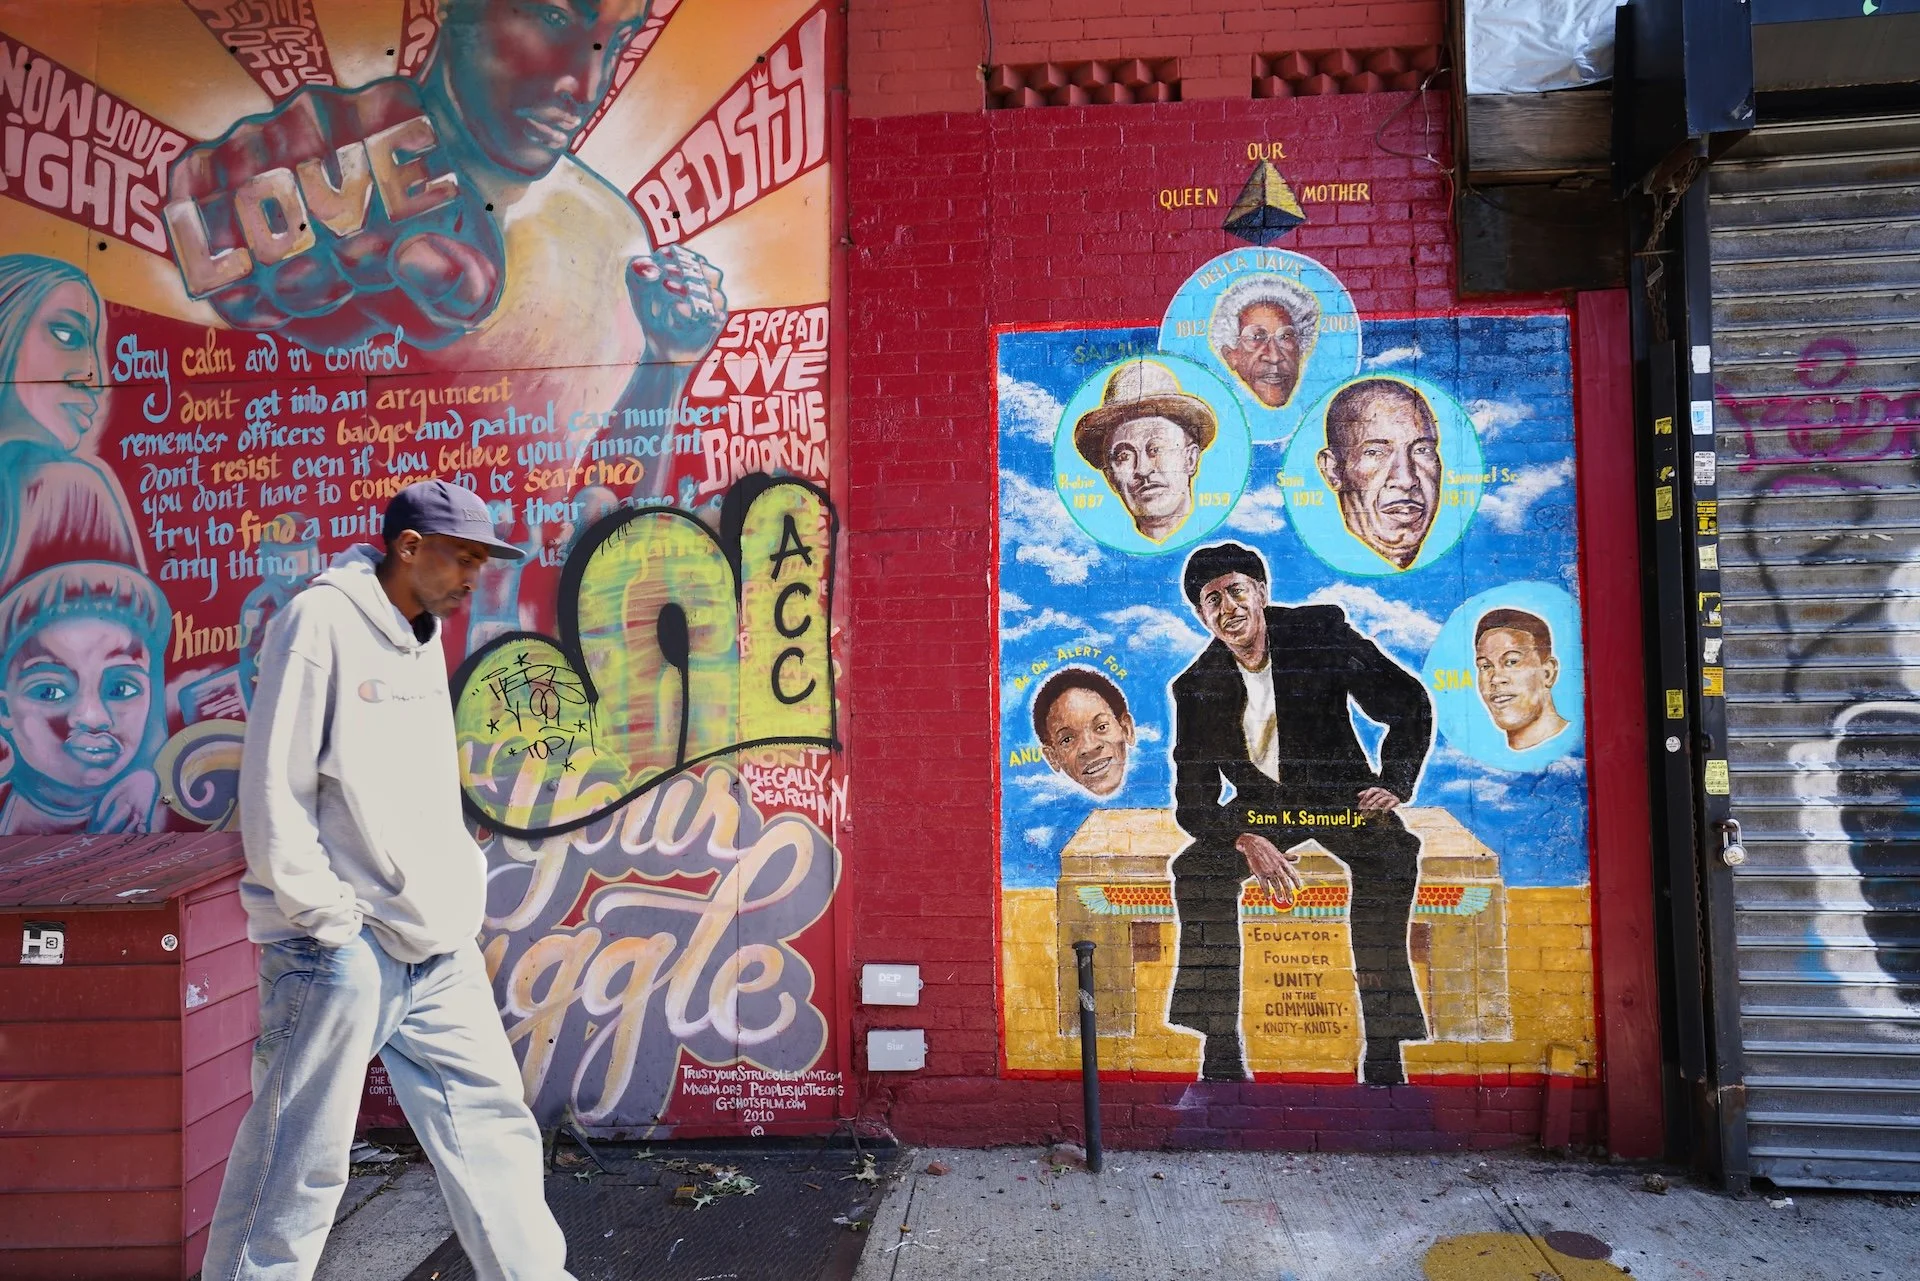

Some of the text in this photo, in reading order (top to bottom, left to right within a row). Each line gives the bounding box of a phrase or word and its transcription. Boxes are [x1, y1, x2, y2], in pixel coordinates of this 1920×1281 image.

[222, 27, 310, 46] OR
[241, 34, 323, 68] JUST
[261, 67, 333, 96] US
[1247, 143, 1287, 160] OUR
[163, 114, 458, 298] LOVE
[1159, 183, 1370, 210] QUEEN MOTHER
[1197, 254, 1303, 288] DELLA DAVIS
[717, 306, 829, 351] SPREAD
[111, 325, 409, 423] Stay calm and in control
[179, 388, 241, 424] don't
[244, 391, 283, 423] get
[331, 388, 368, 413] an
[375, 376, 513, 424] argument
[772, 390, 827, 443] THE
[120, 423, 228, 460] remember
[237, 421, 326, 452] officers
[415, 410, 464, 441] and
[470, 400, 559, 449] patrol
[567, 408, 618, 432] car
[624, 396, 728, 428] number
[140, 456, 205, 495] don't
[211, 452, 282, 484] resist
[292, 457, 345, 480] even
[350, 445, 374, 477] if
[387, 449, 428, 475] you
[439, 441, 510, 473] believe
[591, 430, 704, 461] innocent
[699, 427, 829, 495] BROOKLYN
[1446, 466, 1497, 484] Samuel
[142, 489, 182, 531] you
[192, 482, 249, 513] don't
[260, 481, 308, 508] have
[314, 483, 342, 508] to
[453, 469, 477, 493] to
[490, 466, 514, 494] be
[523, 457, 644, 493] searched
[150, 519, 200, 560] try
[205, 516, 234, 546] to
[236, 509, 296, 552] find
[301, 517, 321, 541] a
[521, 496, 588, 526] their
[160, 556, 218, 603] any
[226, 551, 300, 584] thing
[172, 610, 253, 663] Know
[1056, 646, 1102, 662] ALERT
[1102, 655, 1129, 680] FOR
[1432, 669, 1474, 692] SHA
[743, 759, 831, 793] ILLEGALLY
[751, 781, 817, 811] SEARCH
[1247, 810, 1277, 826] Sam
[1283, 811, 1296, 825] K.
[1299, 808, 1350, 826] Samuel
[1273, 973, 1323, 987] UNITY
[1282, 991, 1317, 1000] IN THE
[1265, 1002, 1343, 1017] COMMUNITY
[1263, 1021, 1341, 1035] KNOTY-KNOTS
[743, 1110, 775, 1122] 2010
